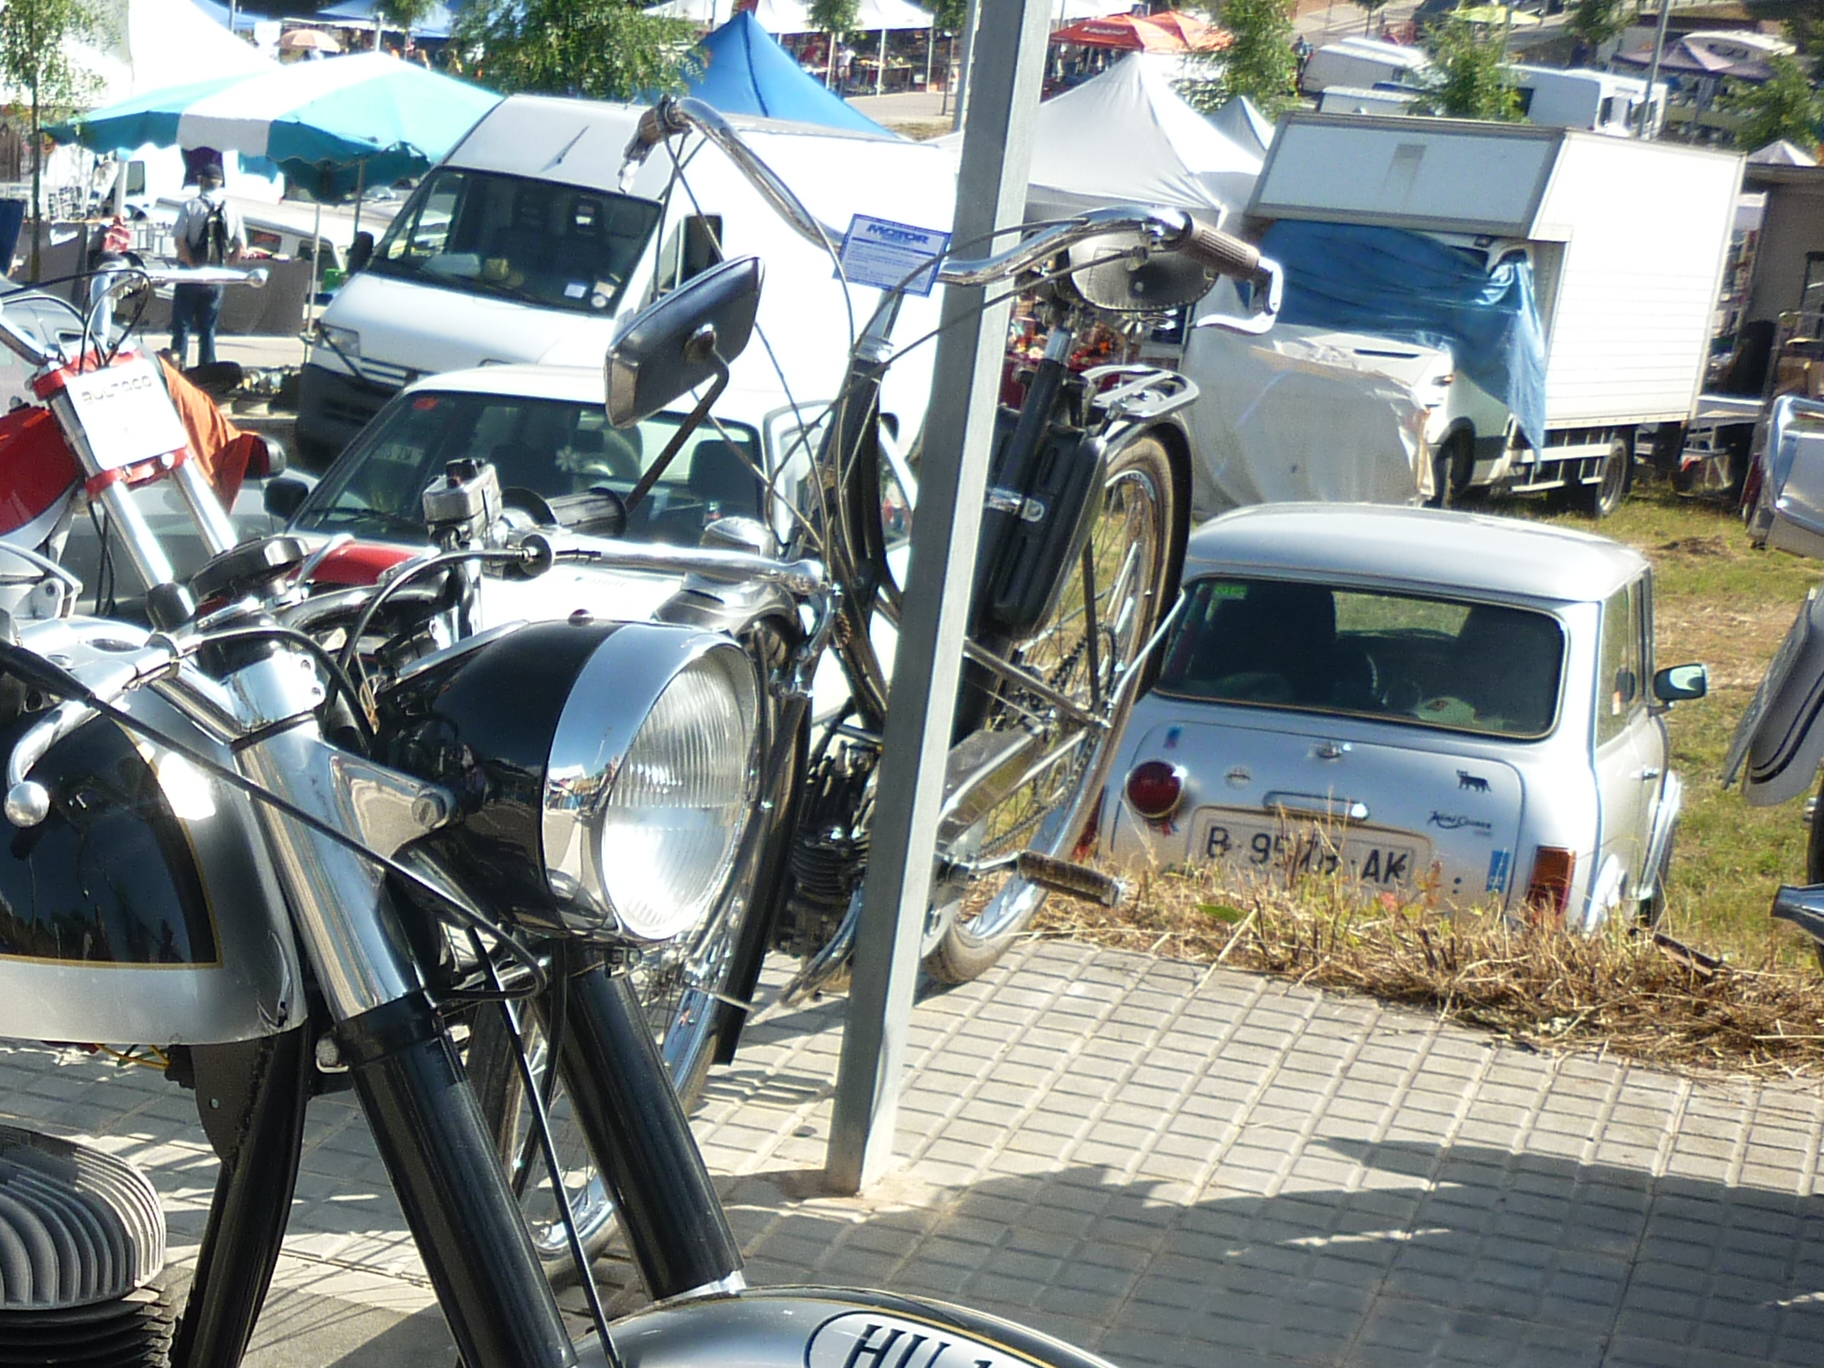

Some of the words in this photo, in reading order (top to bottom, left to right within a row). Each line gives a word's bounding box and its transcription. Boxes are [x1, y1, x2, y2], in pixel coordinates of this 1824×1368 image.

[866, 223, 930, 244] MOTOR
[81, 374, 153, 405] BULTACO
[1362, 849, 1409, 884] AK
